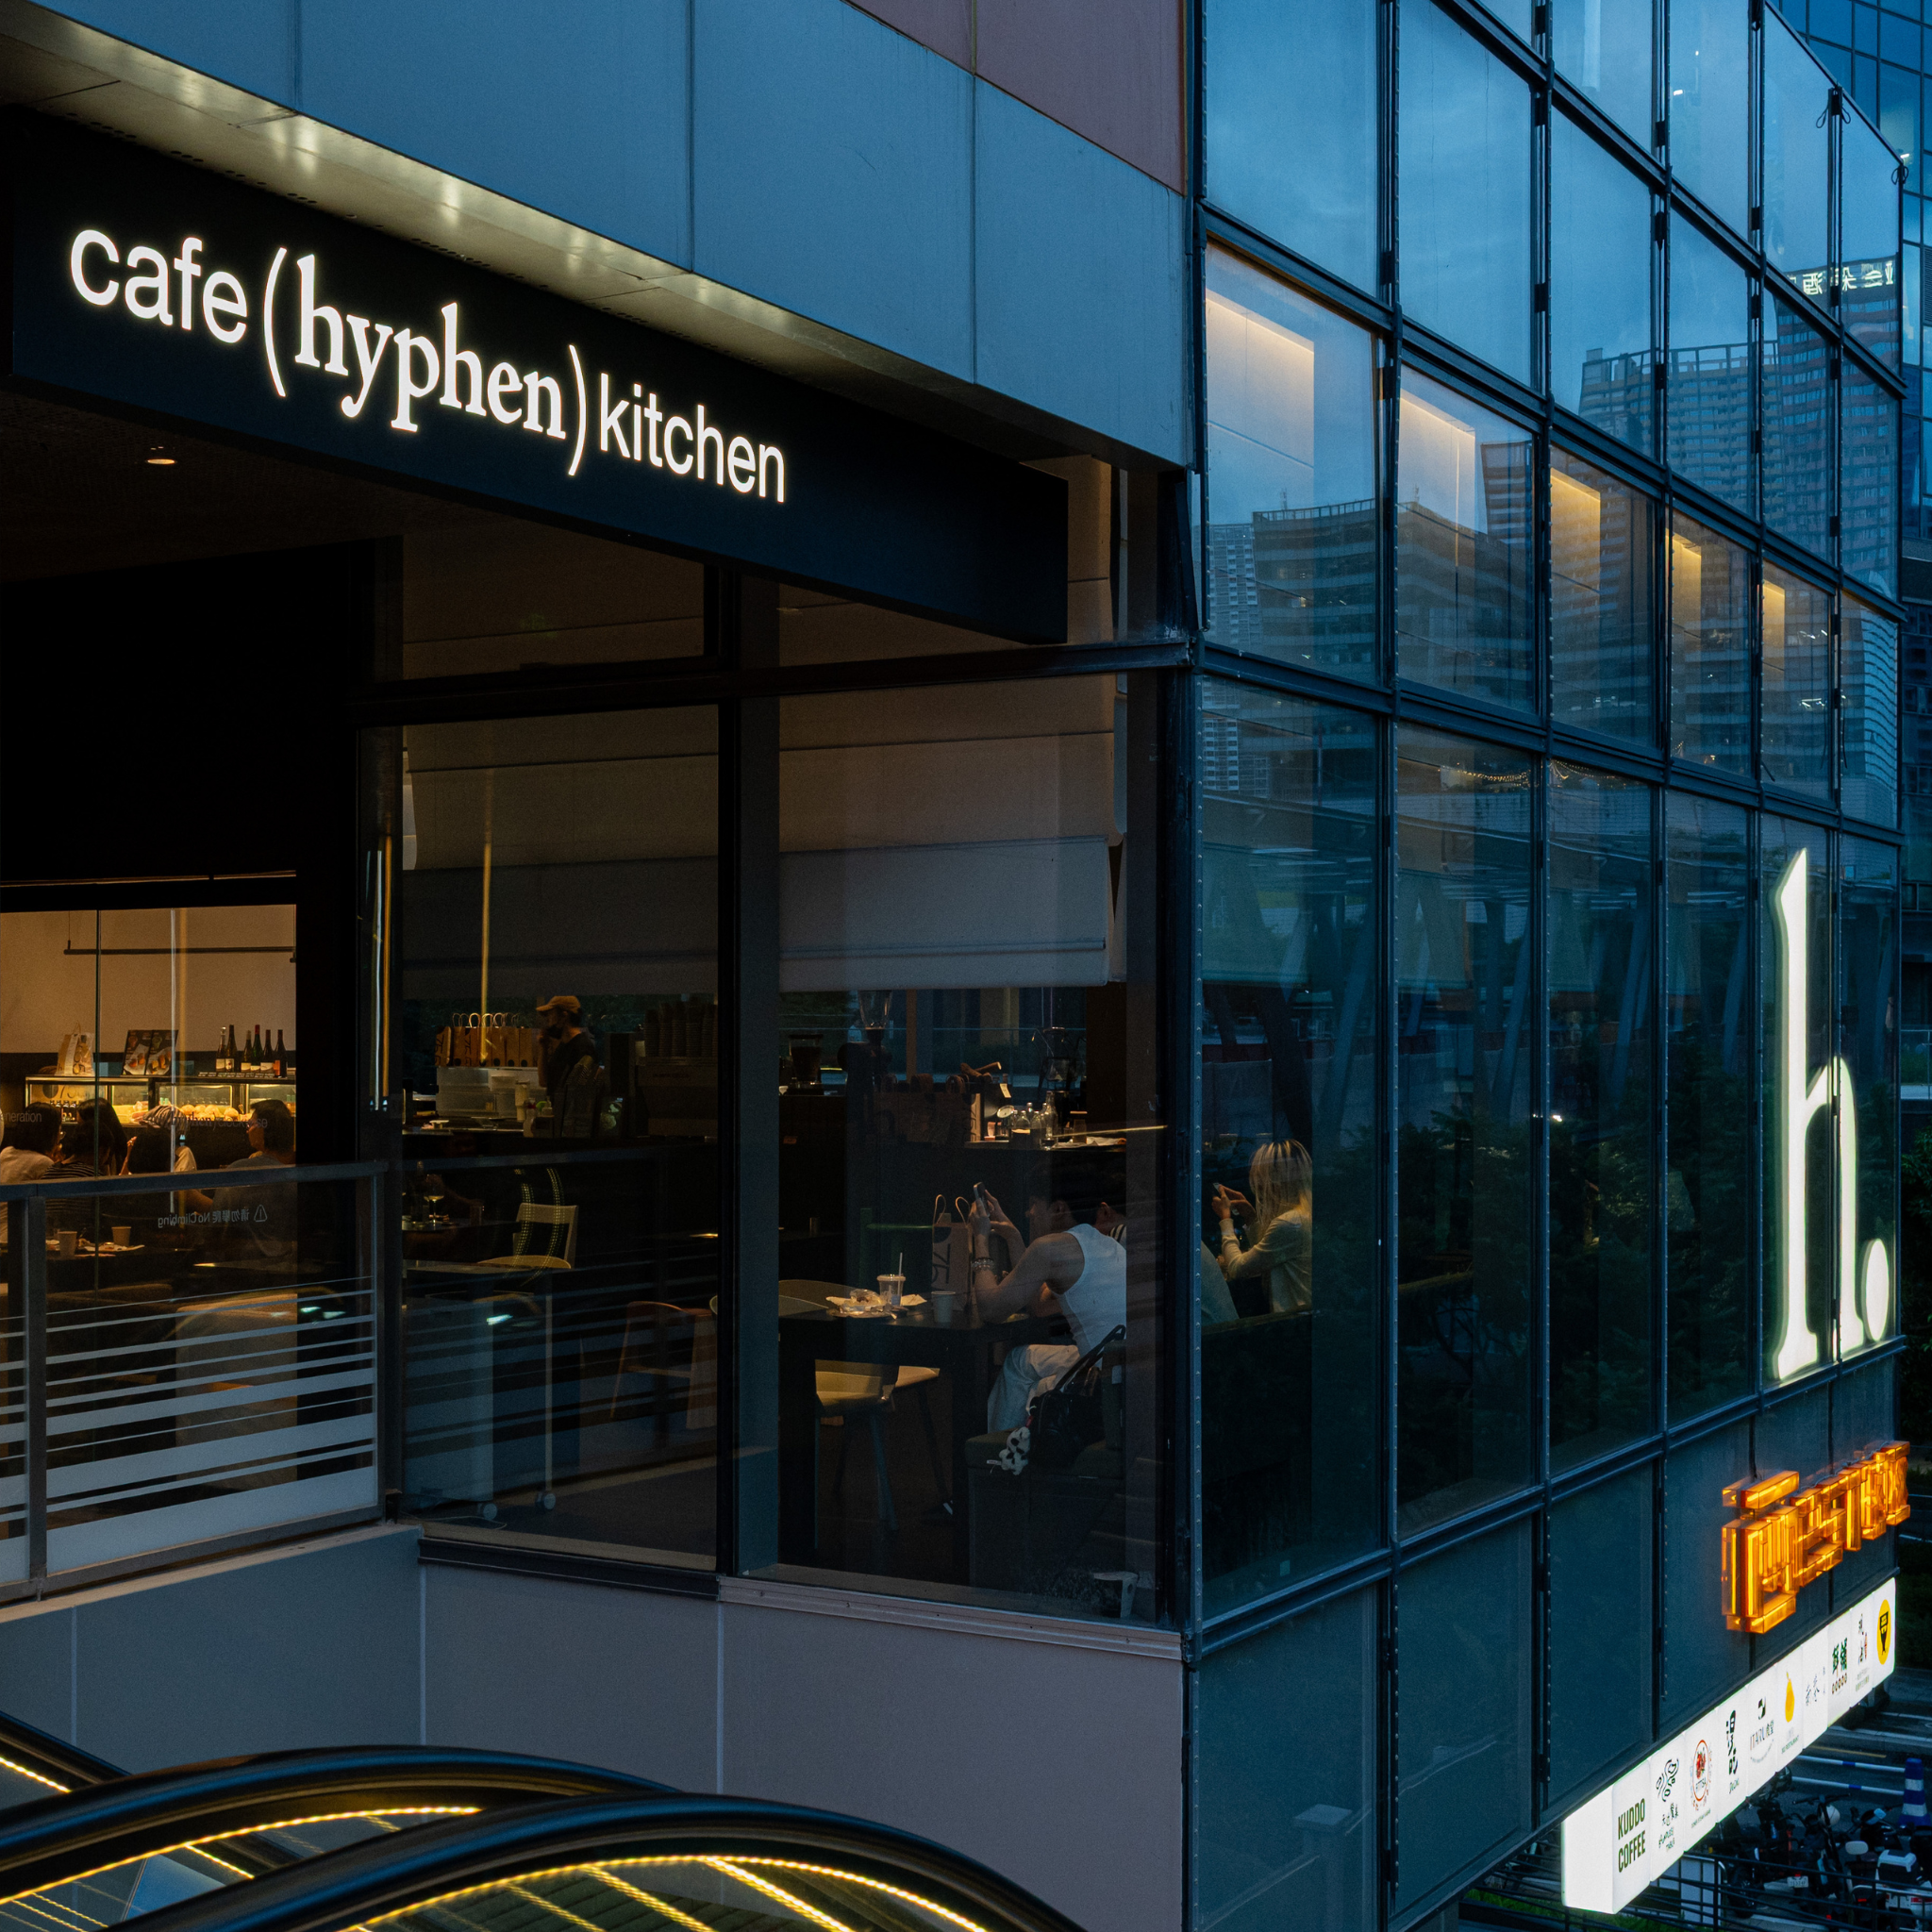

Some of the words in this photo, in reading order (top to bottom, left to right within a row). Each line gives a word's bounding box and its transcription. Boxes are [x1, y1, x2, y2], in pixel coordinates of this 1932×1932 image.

[70, 228, 249, 345] cafe
[598, 371, 787, 504] kitchen
[1617, 1797, 1646, 1840] KUDDO
[1617, 1829, 1646, 1874] COFFEE
